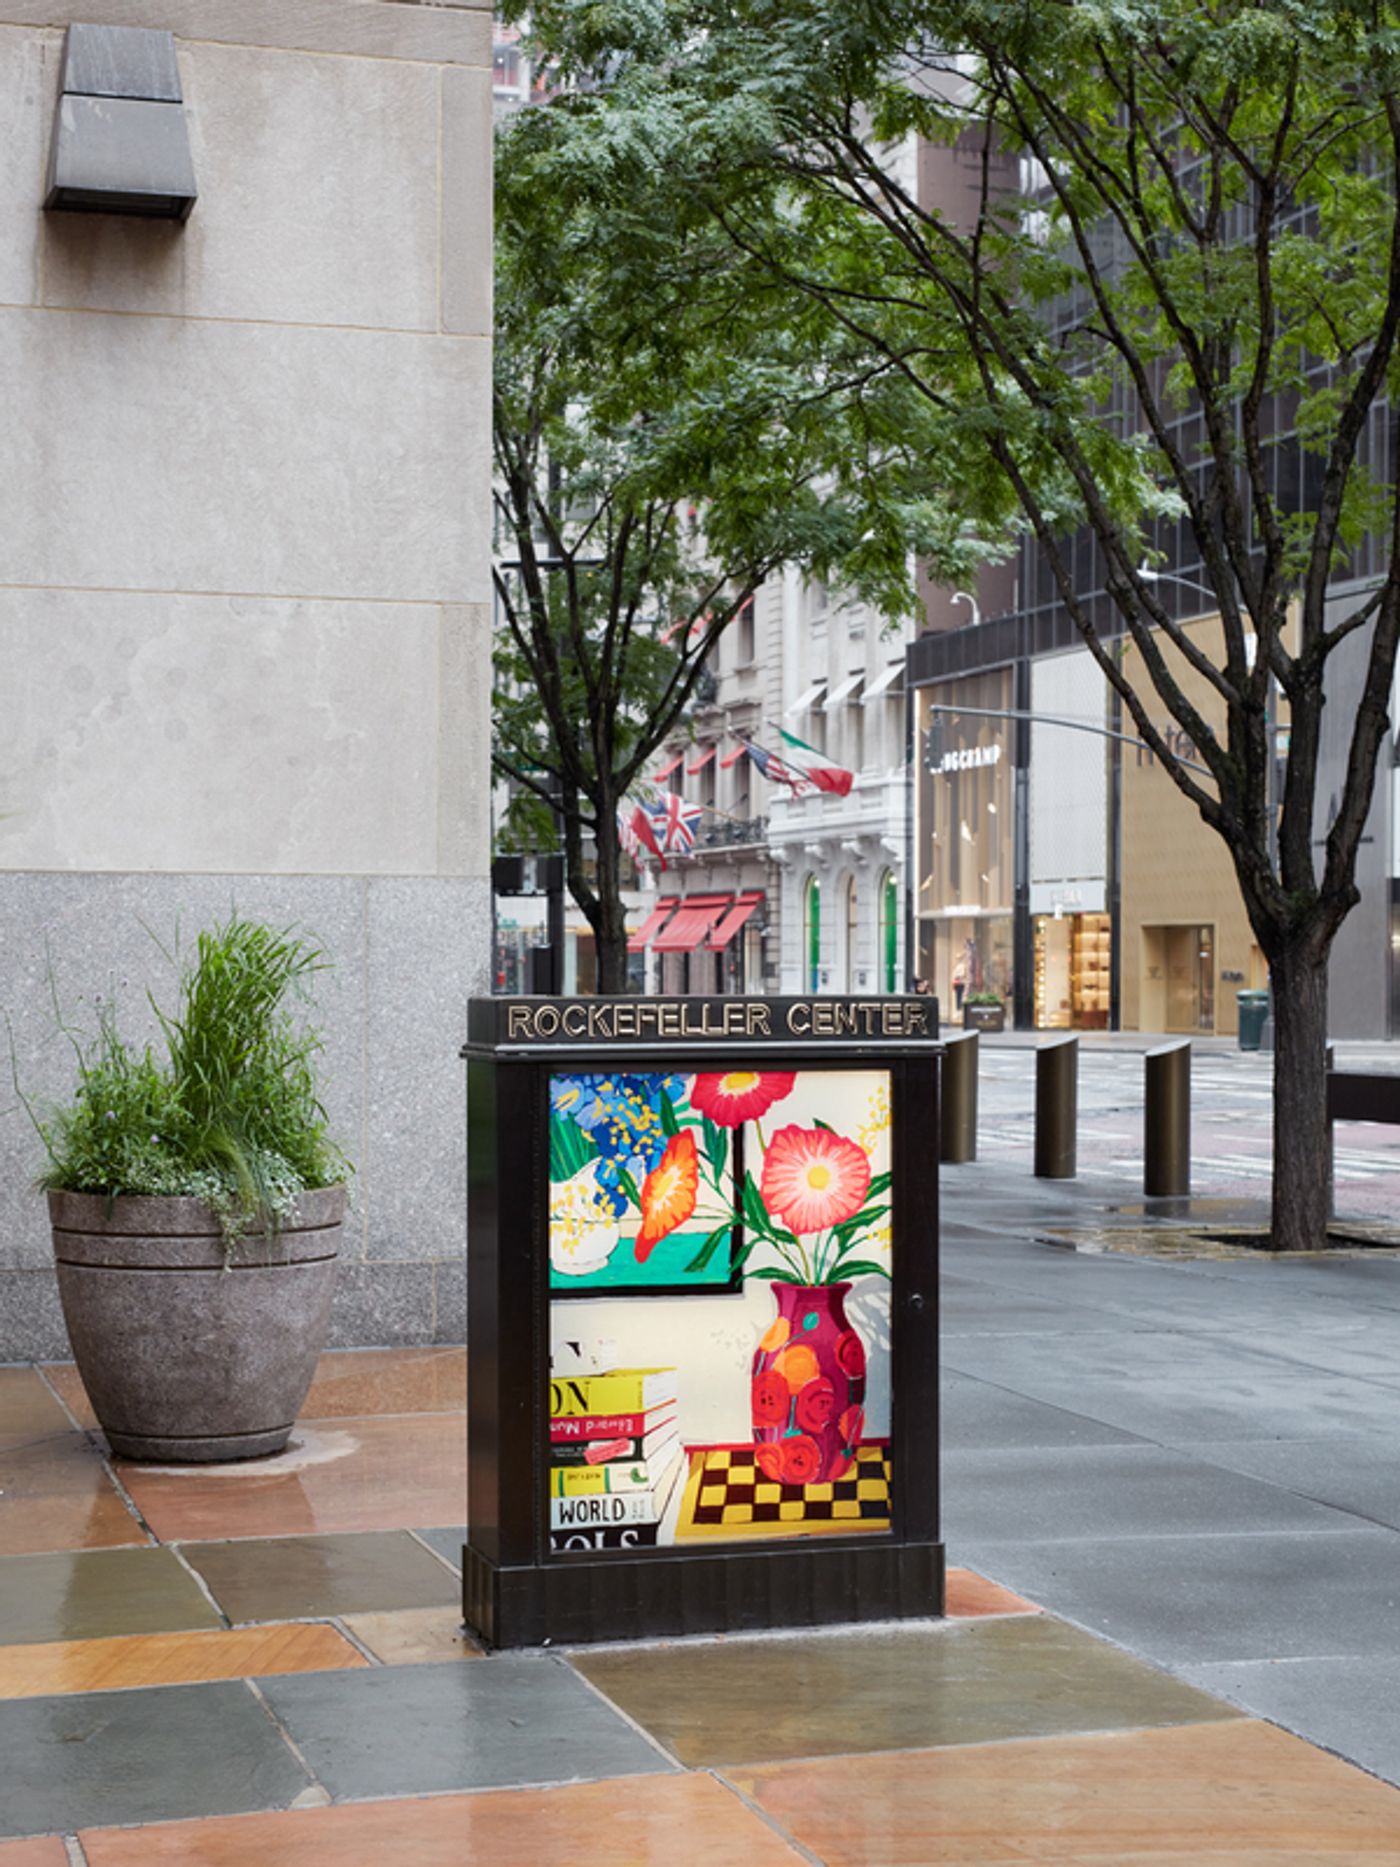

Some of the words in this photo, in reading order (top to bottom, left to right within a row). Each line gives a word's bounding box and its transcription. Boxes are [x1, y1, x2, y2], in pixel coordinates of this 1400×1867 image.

[508, 1003, 771, 1038] ROCKEFELLER
[787, 1003, 929, 1036] CENTER
[559, 1498, 626, 1524] WORLD
